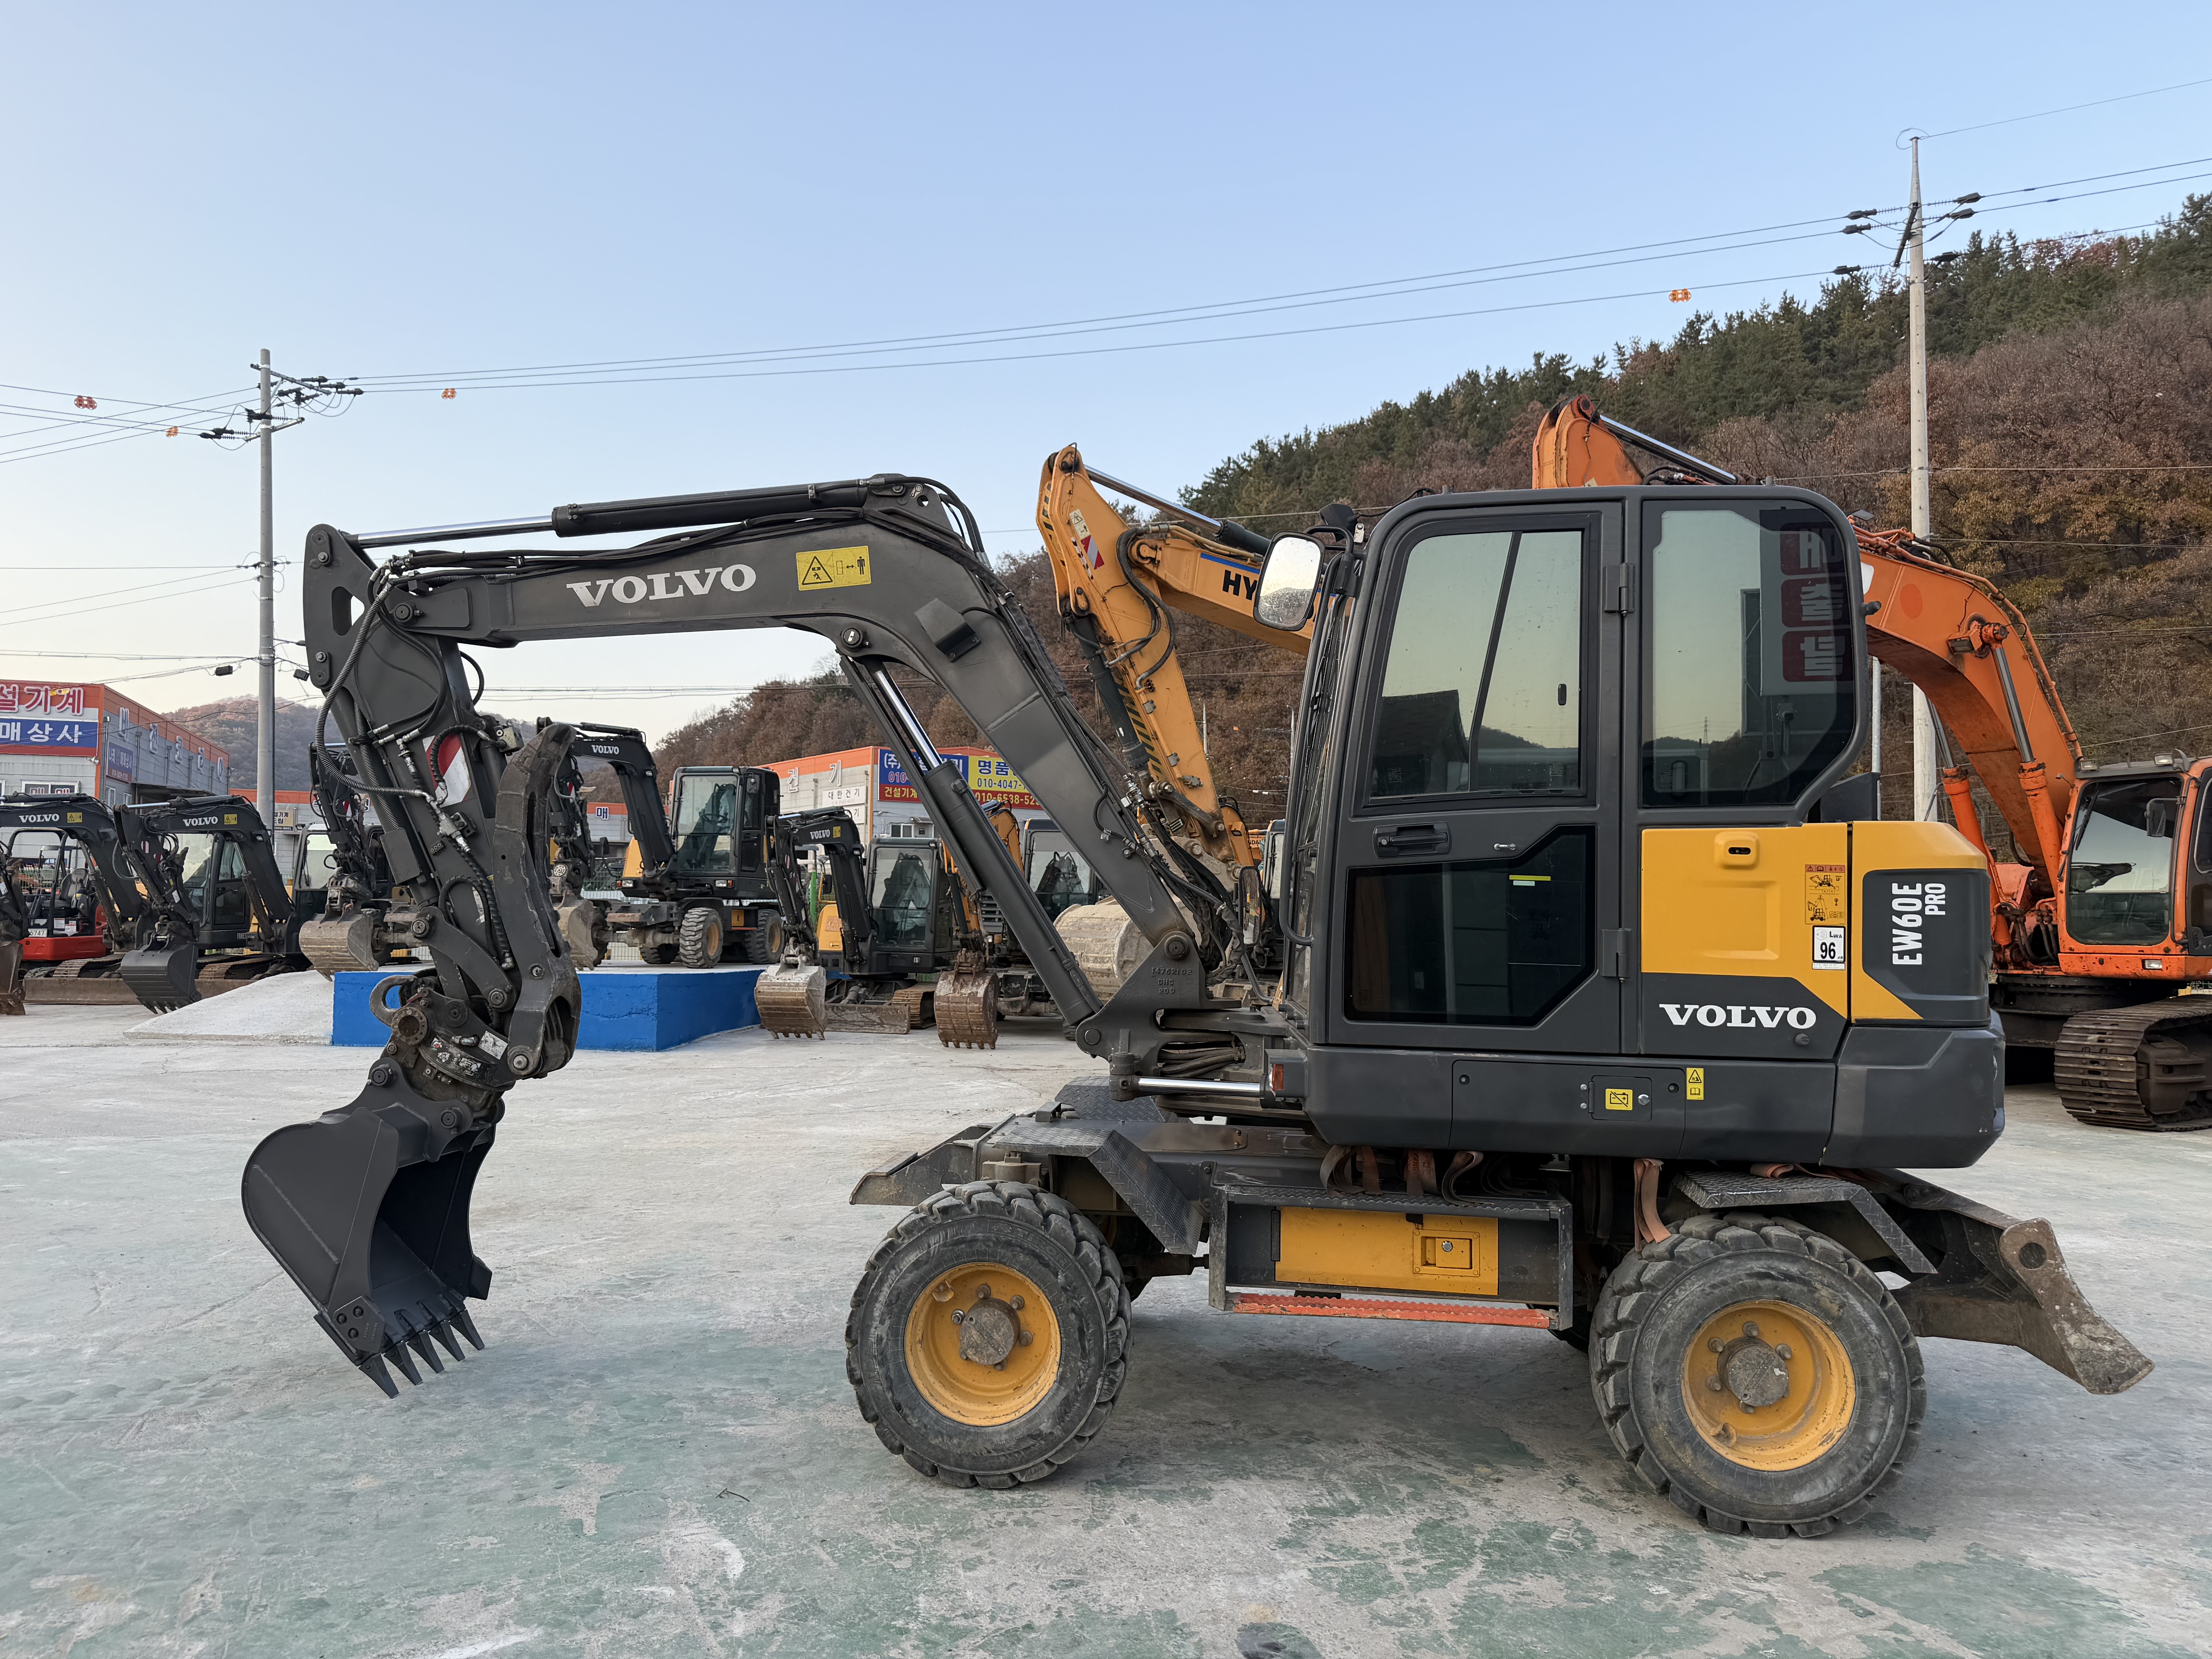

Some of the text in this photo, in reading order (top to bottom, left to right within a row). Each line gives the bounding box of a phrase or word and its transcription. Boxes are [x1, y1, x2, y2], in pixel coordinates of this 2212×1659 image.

[566, 564, 756, 607] VOLVO
[591, 745, 620, 755] VOLVO
[19, 813, 60, 823] VOLVO
[596, 807, 609, 820] 매
[182, 816, 218, 827] VOLVO
[810, 829, 830, 840] VOLVO
[1924, 883, 1946, 915] PRO
[1892, 883, 1922, 965] EW60E
[1820, 942, 1836, 959] 96
[1659, 1003, 1817, 1029] VOLVO
